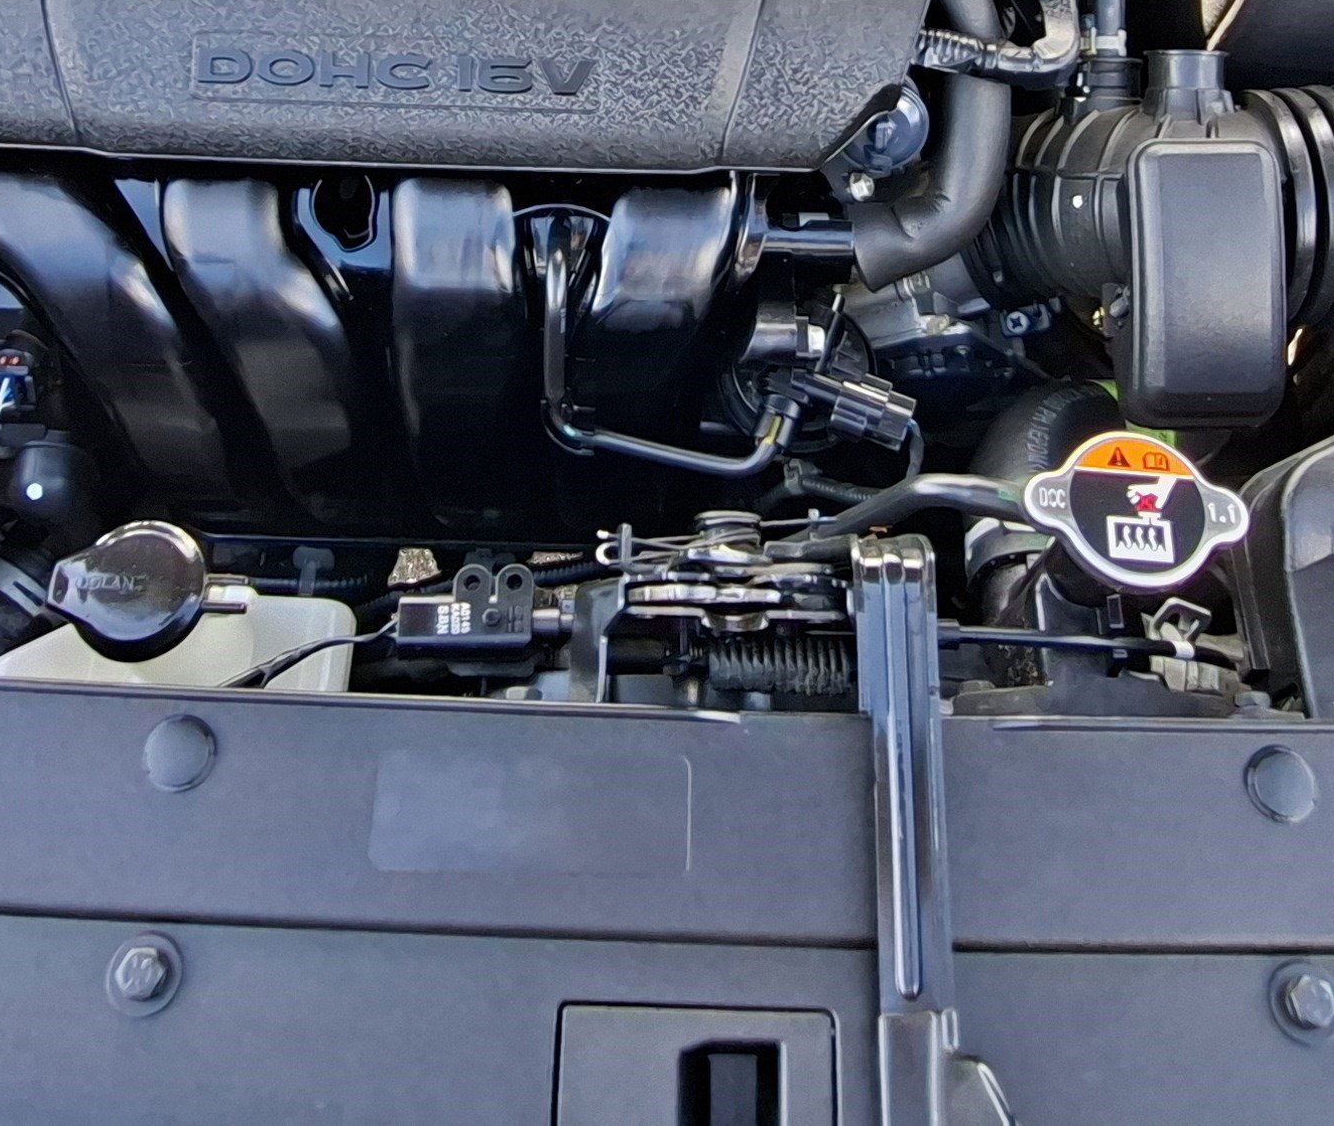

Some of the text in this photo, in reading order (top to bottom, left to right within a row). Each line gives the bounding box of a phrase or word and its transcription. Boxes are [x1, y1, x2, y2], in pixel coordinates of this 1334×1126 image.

[197, 48, 598, 97] DOHC 16V
[1207, 502, 1236, 524] 1.1
